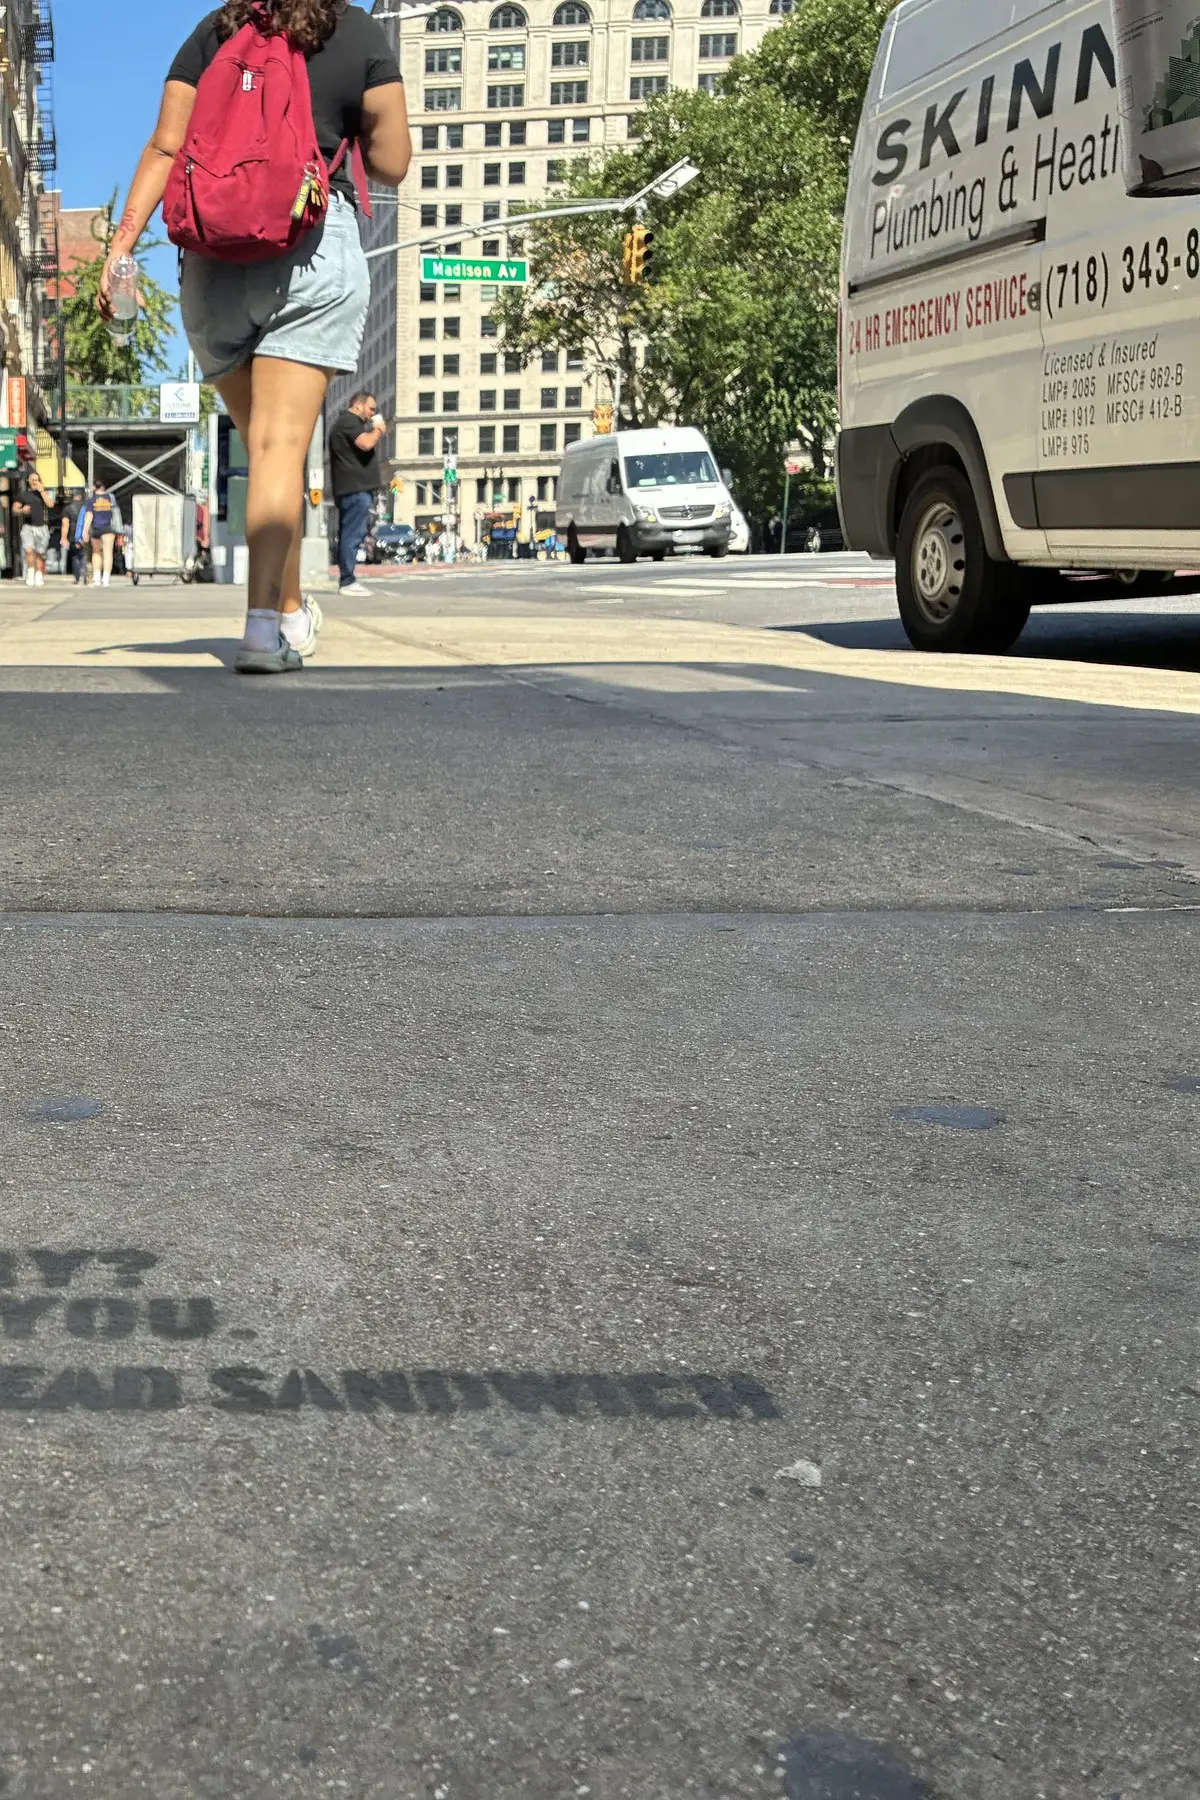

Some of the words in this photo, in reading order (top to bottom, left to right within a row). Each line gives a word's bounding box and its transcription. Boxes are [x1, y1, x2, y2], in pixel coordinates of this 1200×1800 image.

[870, 167, 986, 259] Plumbing
[999, 144, 1018, 213] &
[432, 261, 491, 278] Madison
[498, 264, 518, 279] Av
[1046, 251, 1109, 320] (718)
[1122, 227, 1200, 293] 343-8
[848, 318, 861, 355] 24
[865, 313, 880, 352] HR
[885, 290, 961, 348] EMERGENCY
[965, 272, 1027, 329] SERVICE
[1044, 343, 1095, 376] Licensed
[1098, 342, 1106, 368] &
[1111, 332, 1159, 365] Insured
[1042, 380, 1068, 403] LMP#
[1072, 376, 1096, 399] 2085
[1107, 369, 1145, 396] MFSC#
[1150, 363, 1183, 390] 962-B
[1042, 408, 1067, 431] LMP#
[1072, 405, 1095, 427] 1912
[1106, 399, 1144, 425] MFSC#
[1149, 394, 1182, 420] 412-B
[1042, 435, 1067, 458] LMP#
[1071, 433, 1089, 455] 975
[208, 1368, 782, 1418] SANDWICH
